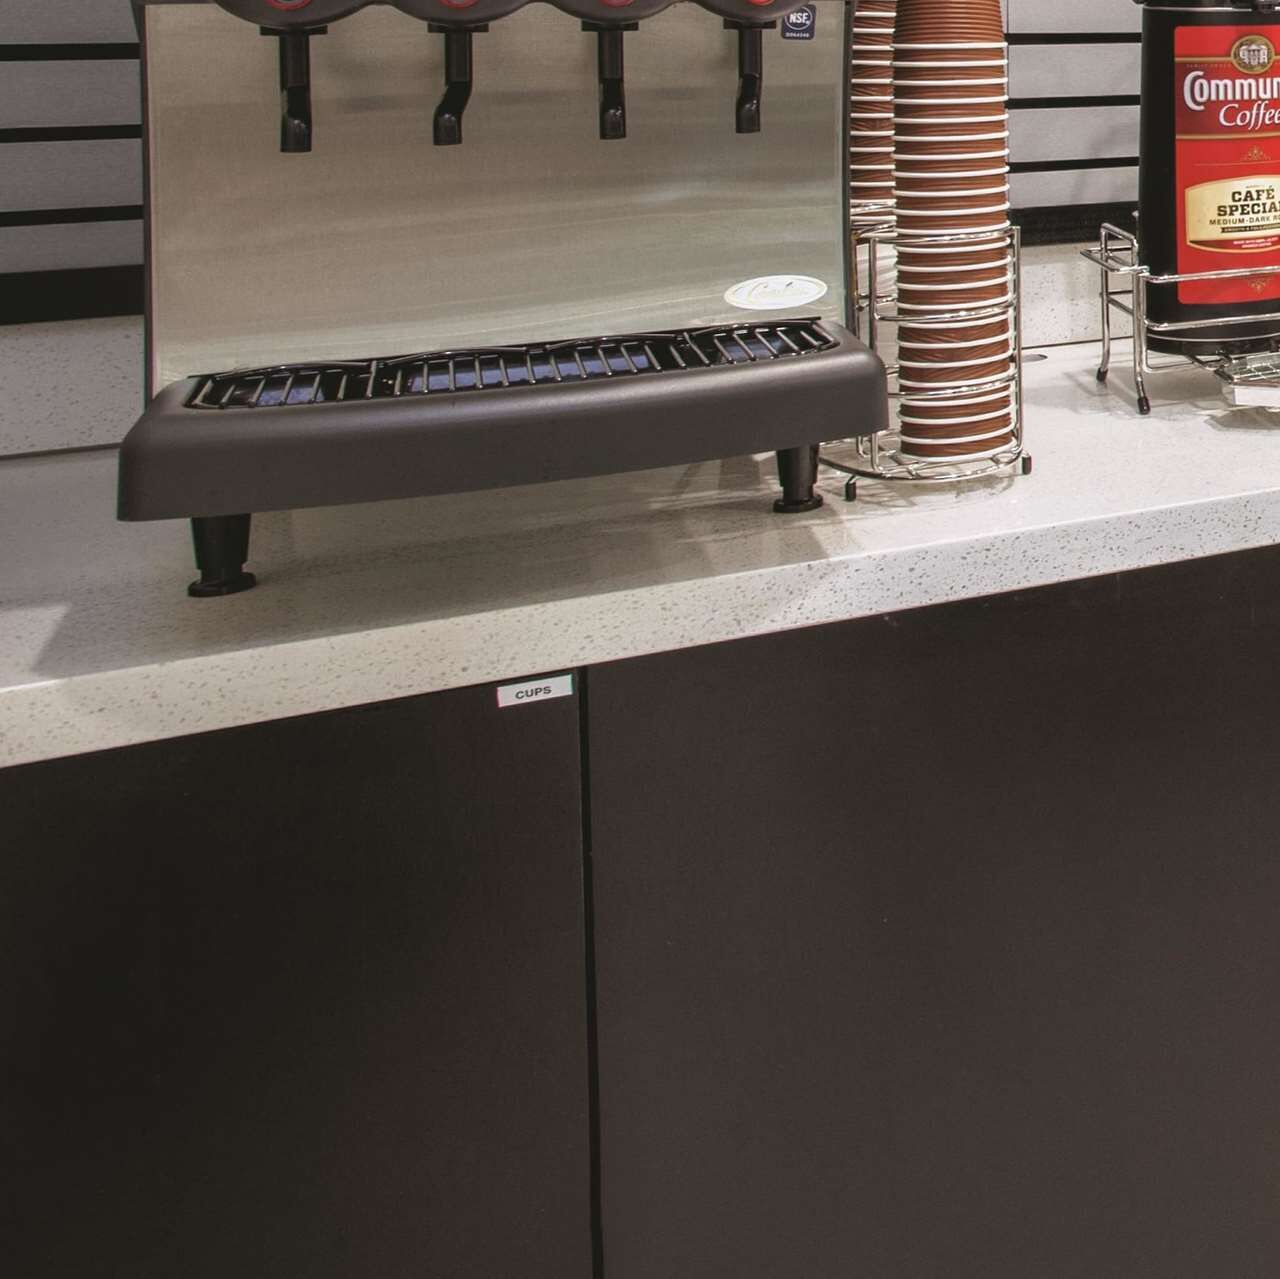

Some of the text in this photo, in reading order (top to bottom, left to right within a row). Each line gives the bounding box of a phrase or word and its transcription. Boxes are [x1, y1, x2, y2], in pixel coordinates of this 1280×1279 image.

[789, 12, 809, 24] NSF
[1231, 186, 1275, 203] CAFÉ
[515, 685, 552, 700] CUPS
